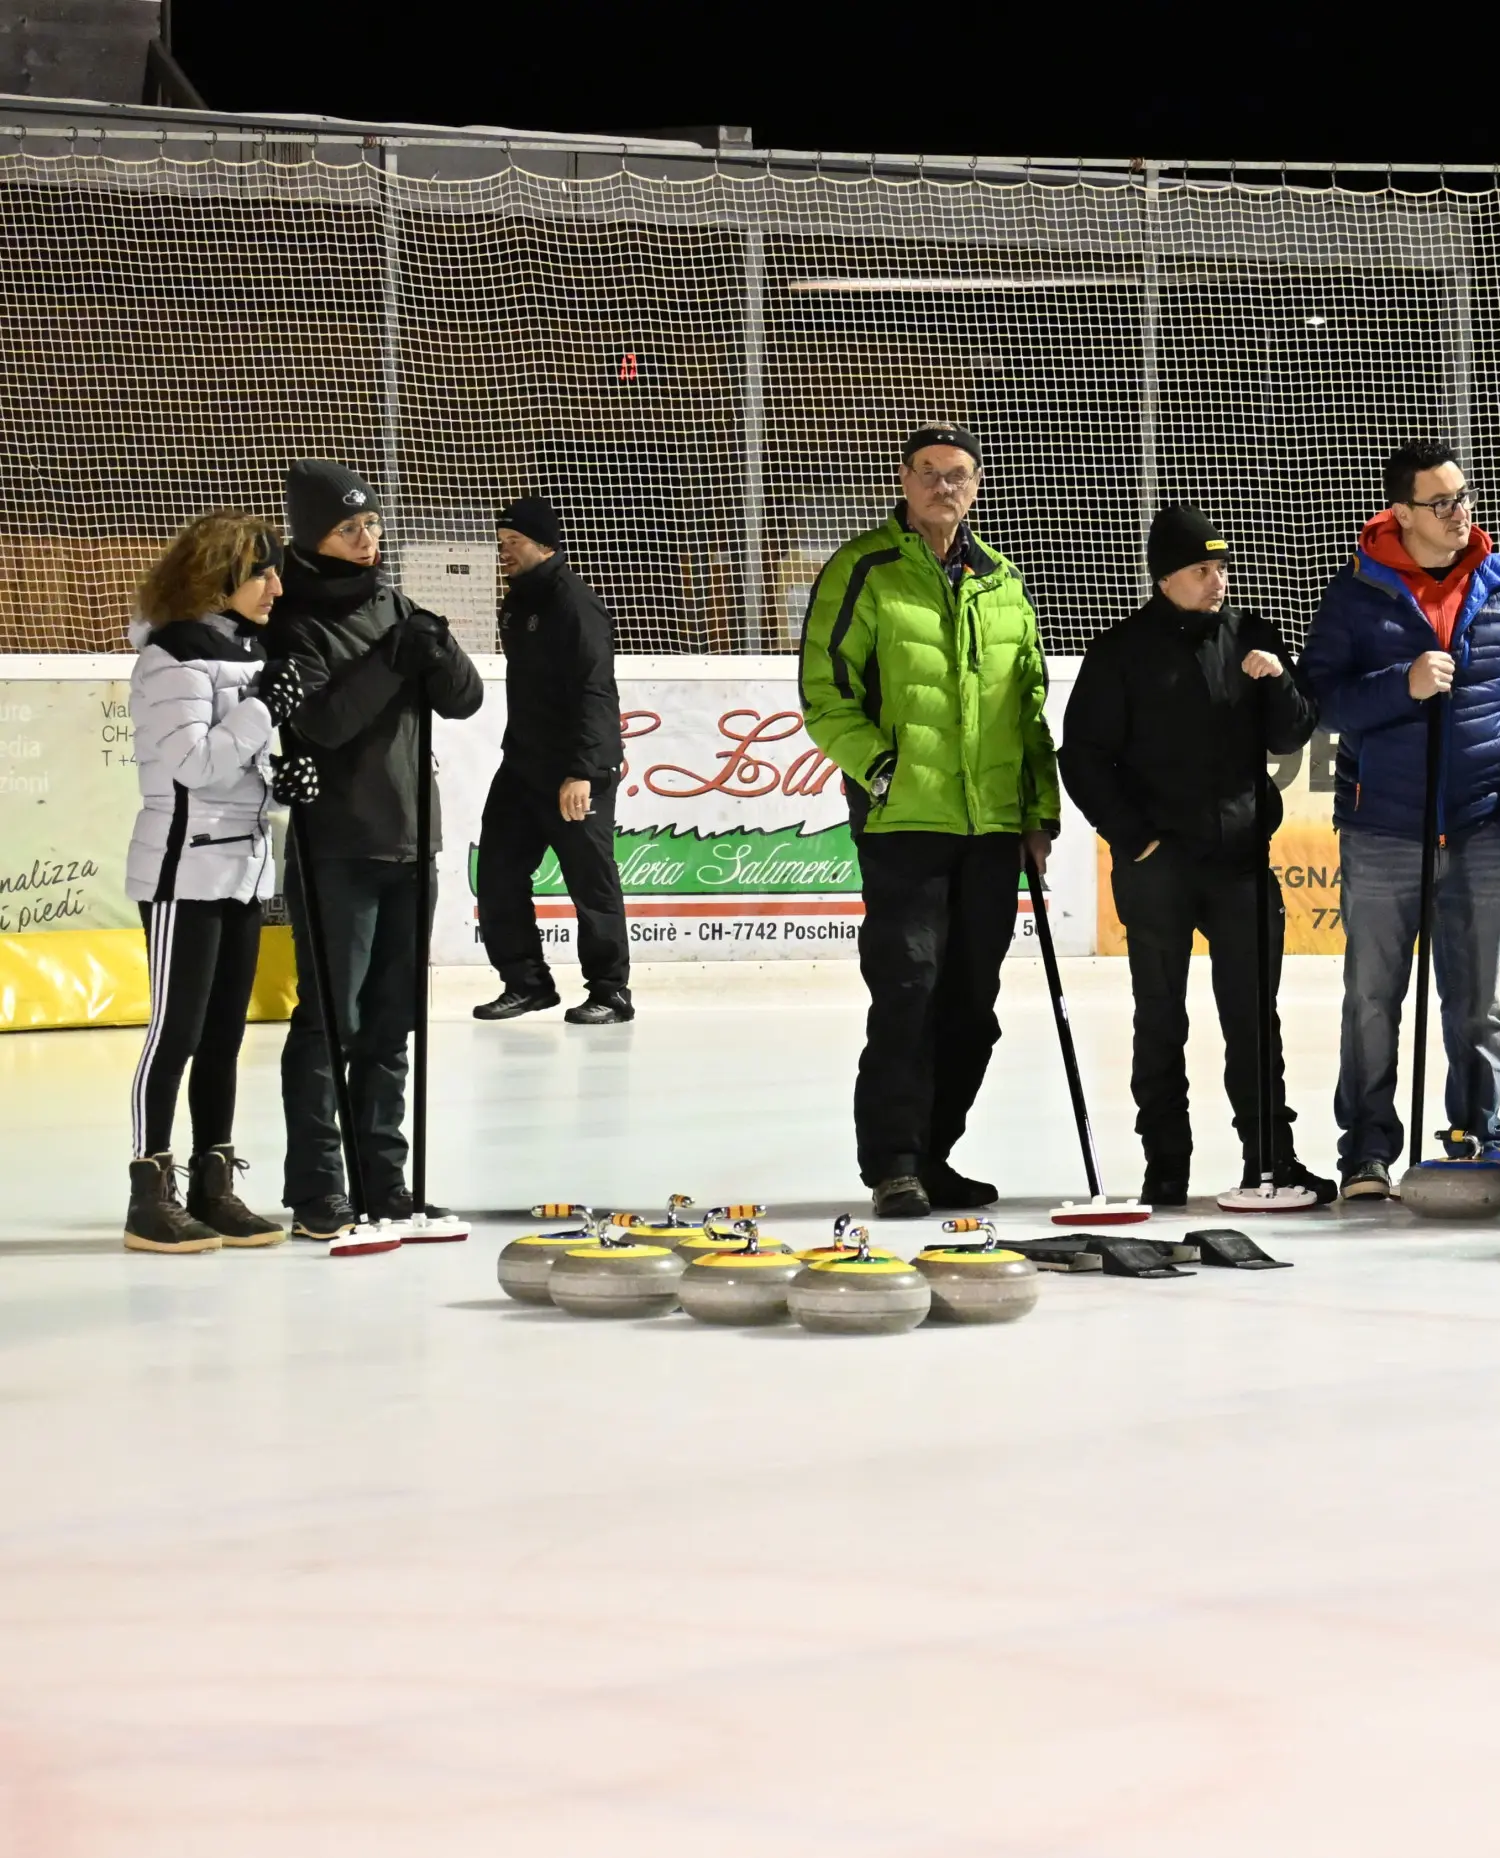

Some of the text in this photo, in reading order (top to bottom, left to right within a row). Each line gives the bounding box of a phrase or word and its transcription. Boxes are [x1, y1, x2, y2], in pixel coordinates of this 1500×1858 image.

[101, 749, 113, 767] T
[696, 843, 855, 886] Salumeria
[630, 922, 677, 942] Scirè
[699, 922, 777, 941] CH-7742
